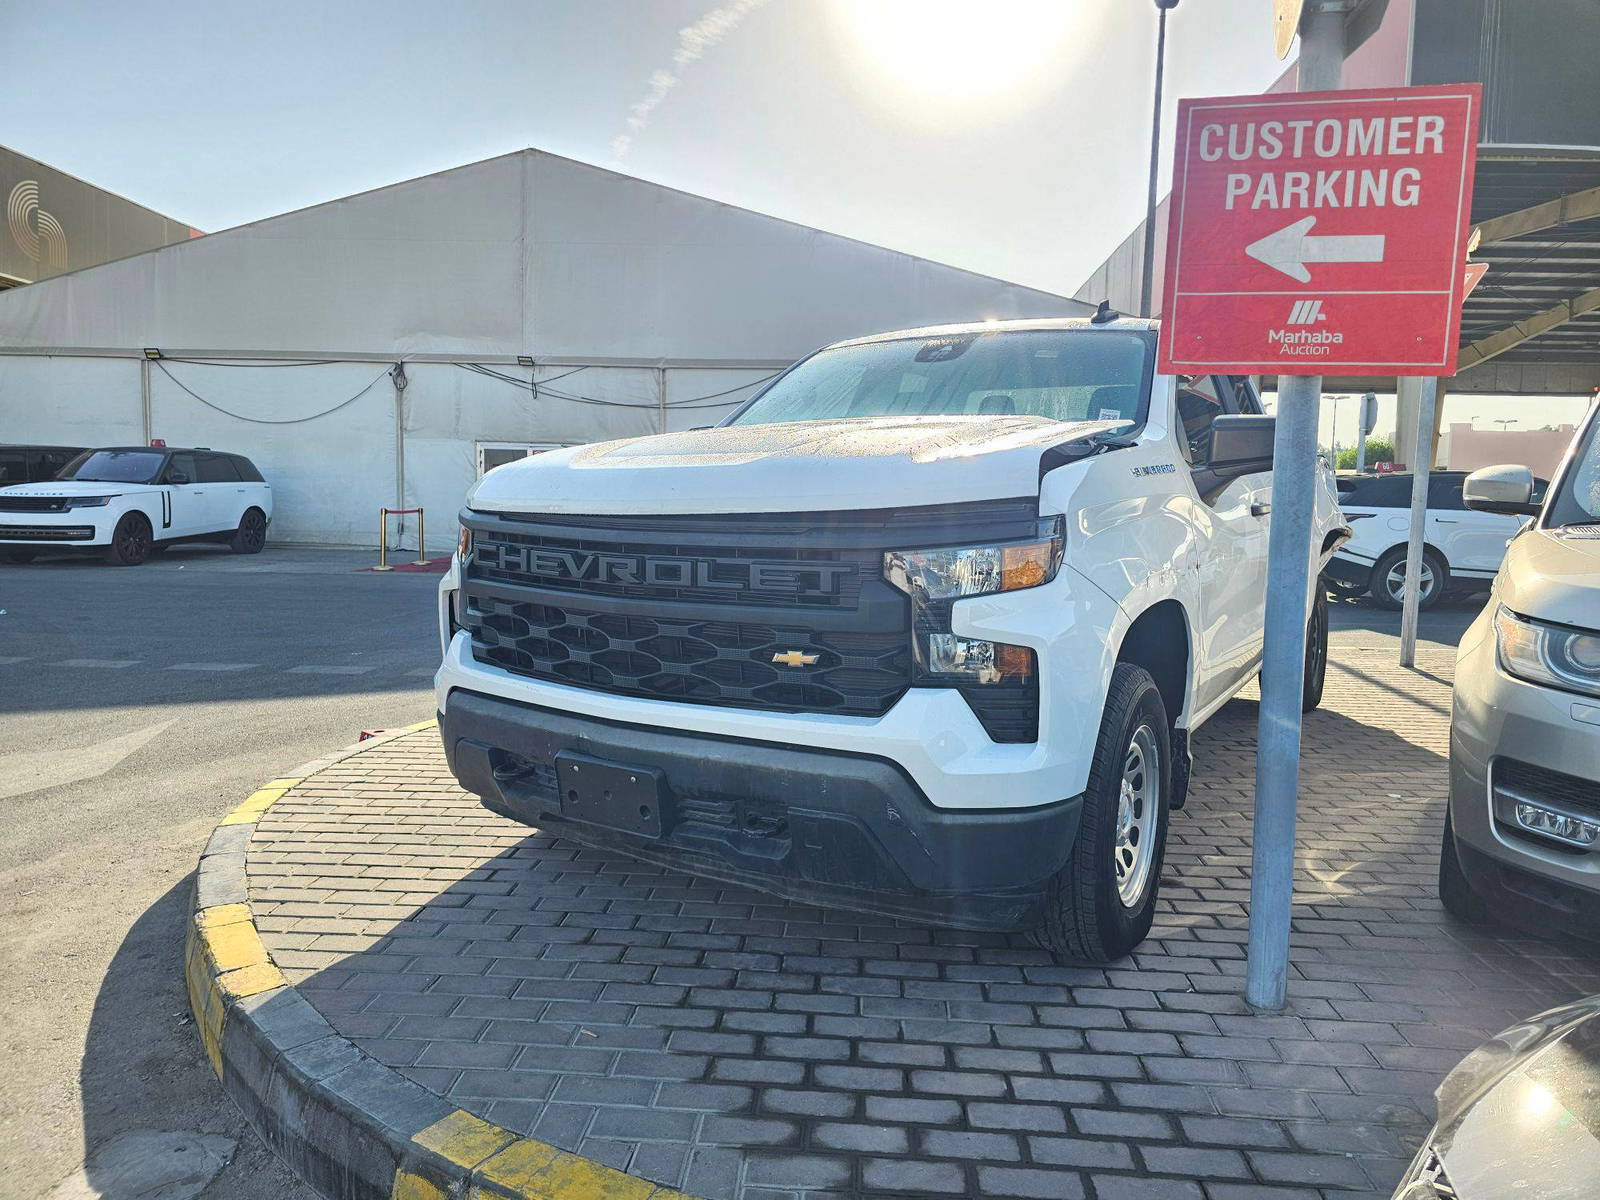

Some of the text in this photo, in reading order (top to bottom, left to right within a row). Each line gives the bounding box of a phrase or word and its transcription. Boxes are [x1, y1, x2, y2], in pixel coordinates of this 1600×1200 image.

[1199, 115, 1445, 162] CUSTOMER
[1225, 167, 1421, 210] PARKING
[1267, 329, 1343, 344] Marhaba
[1279, 343, 1330, 355] Auction
[473, 543, 852, 594] CHEVROLET
